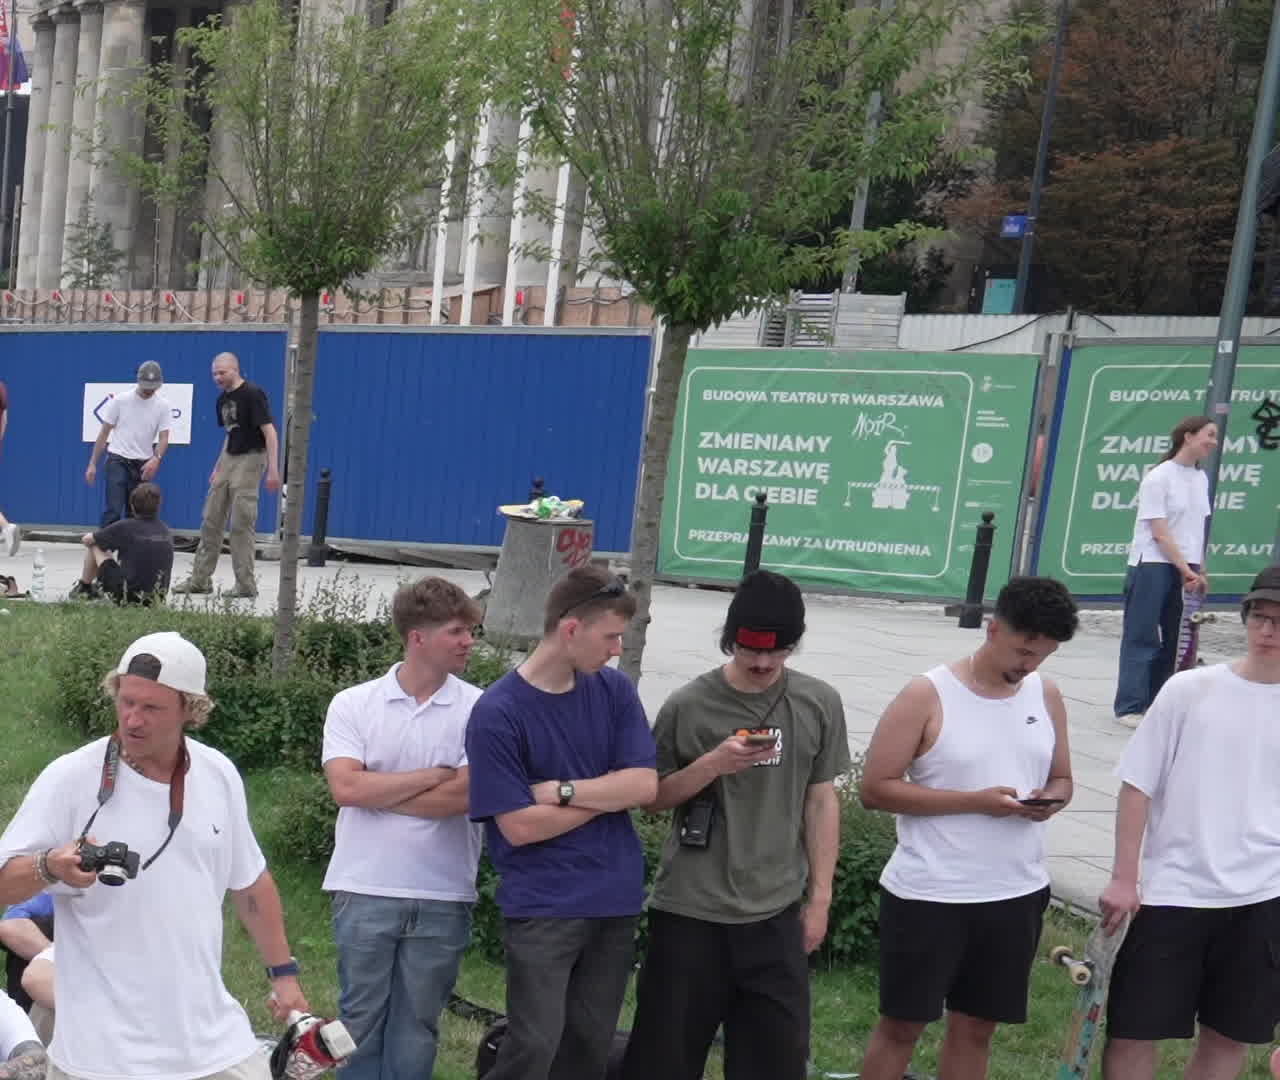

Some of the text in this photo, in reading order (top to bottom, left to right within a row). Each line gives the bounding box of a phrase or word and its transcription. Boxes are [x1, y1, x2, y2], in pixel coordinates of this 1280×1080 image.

[702, 389, 945, 408] BUDOWA TEATRU TR WARSZAWA
[1109, 389, 1191, 403] BUDOWA
[1192, 389, 1265, 402] TTRU
[698, 431, 833, 453] ZMIENIAMY
[1100, 435, 1263, 454] ZMIEMY
[697, 456, 831, 485] WARSZAWĘ
[695, 482, 819, 505] DLA CIEBIE
[1091, 492, 1139, 510] DLA
[688, 529, 932, 557] PRZEPRAZAMY ZA UTRUDNIENIA
[1224, 543, 1250, 555] ZA
